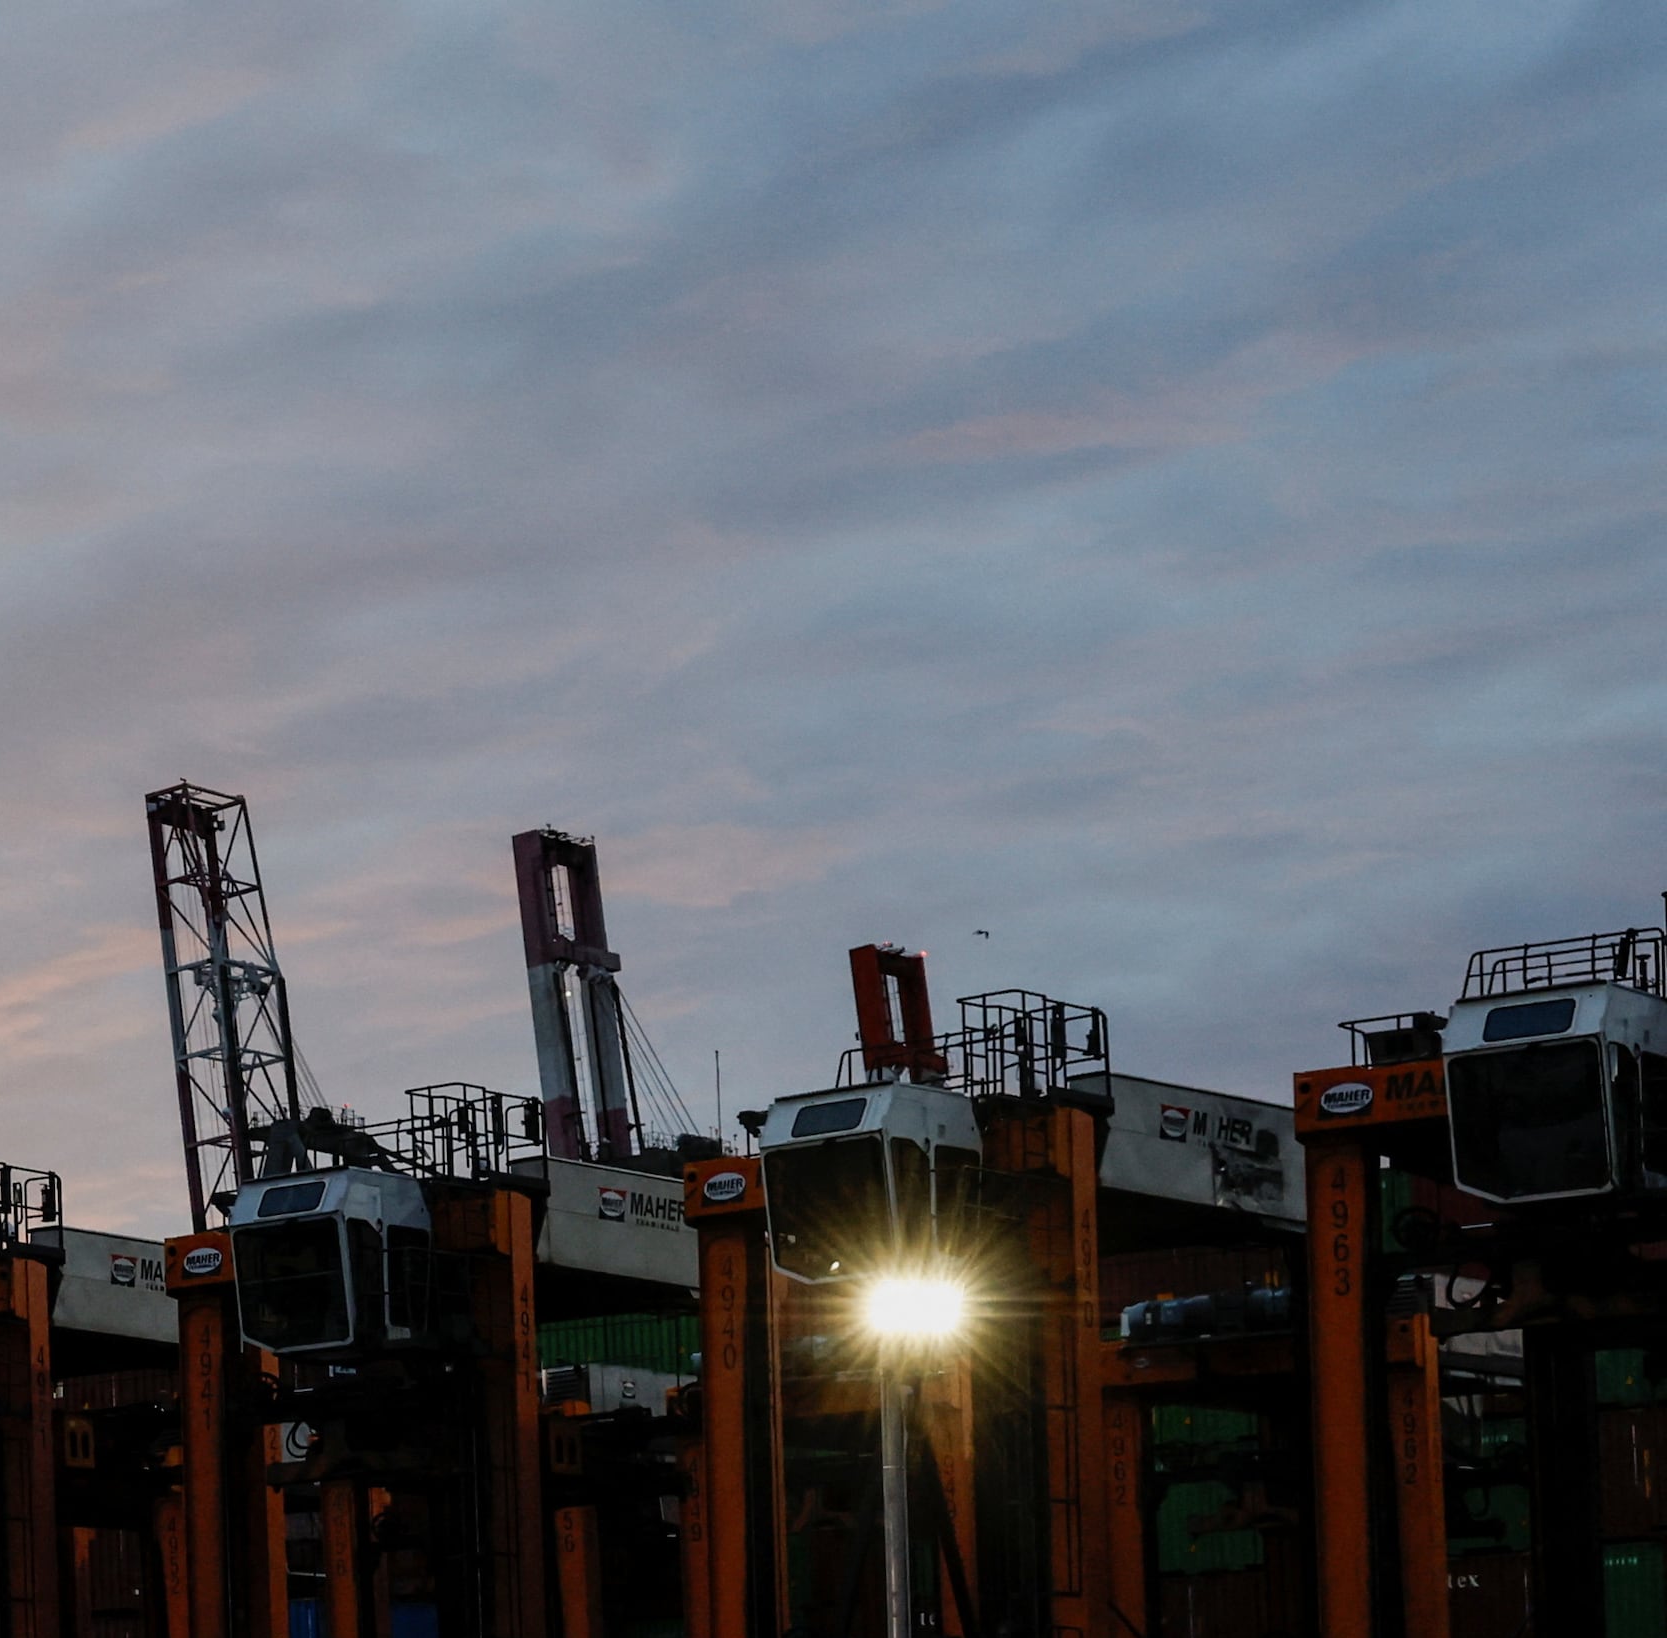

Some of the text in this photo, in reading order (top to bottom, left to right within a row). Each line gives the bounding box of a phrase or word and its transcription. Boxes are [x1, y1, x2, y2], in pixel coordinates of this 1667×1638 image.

[706, 1177, 744, 1193] MAHER
[1331, 1167, 1349, 1296] 4963
[187, 1253, 221, 1266] MAHER
[722, 1256, 736, 1370] 4940
[1081, 1208, 1094, 1327] 4940
[200, 1324, 212, 1432] 4941
[520, 1283, 529, 1392] 4941
[1113, 1410, 1126, 1505] 4962
[1402, 1388, 1417, 1484] 4962
